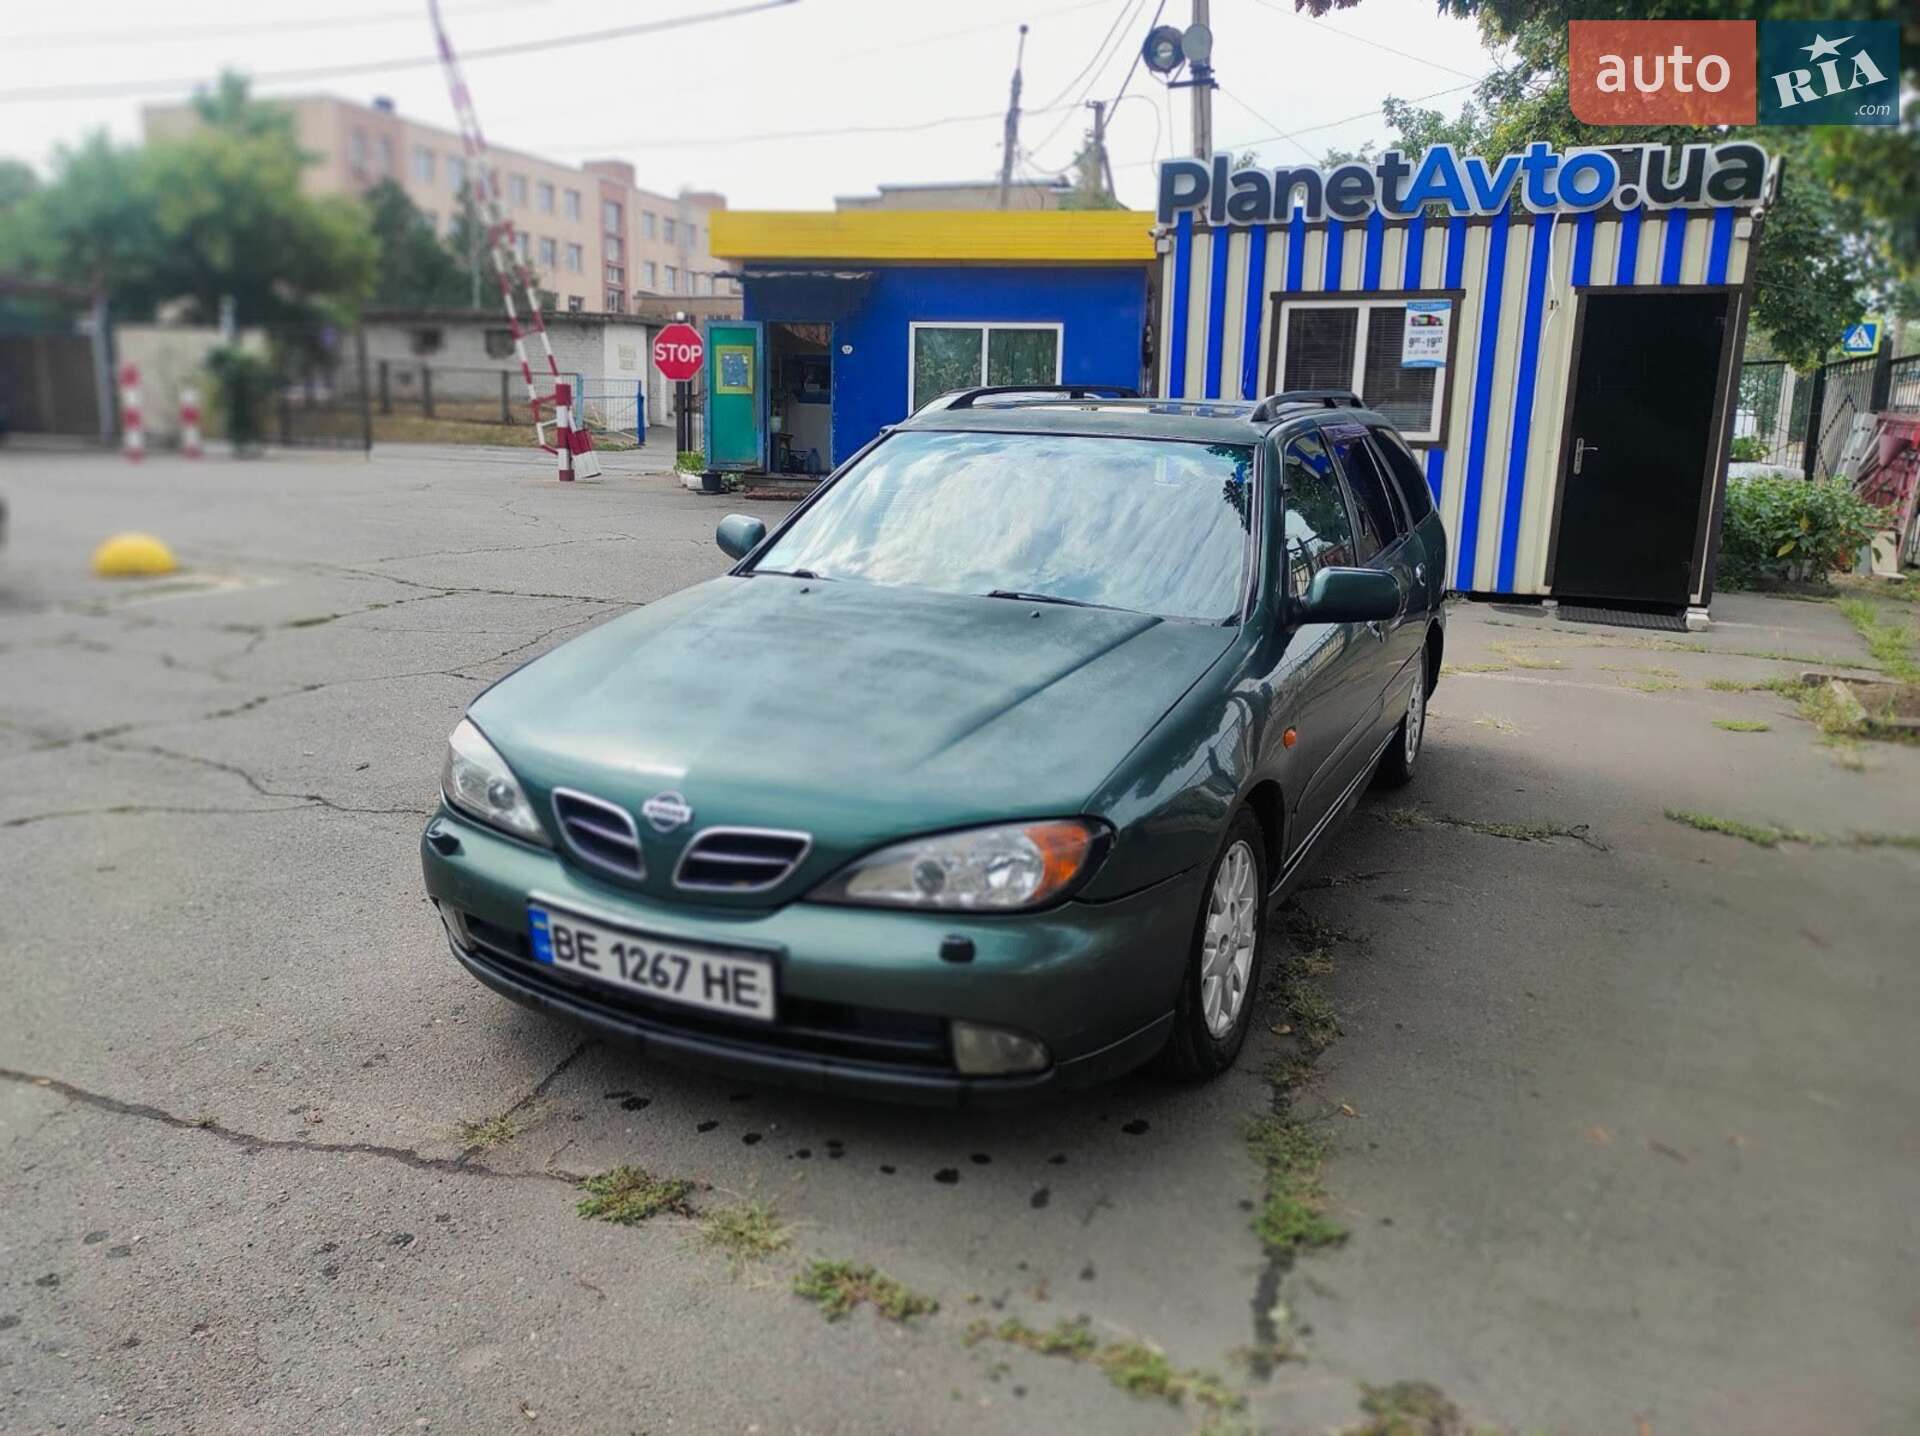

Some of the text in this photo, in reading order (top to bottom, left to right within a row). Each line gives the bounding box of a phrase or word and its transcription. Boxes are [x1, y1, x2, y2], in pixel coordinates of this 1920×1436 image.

[1157, 142, 1767, 224] PlanetAvto.ua
[654, 343, 703, 363] STOP
[552, 925, 761, 1009] BE 1267 HE
